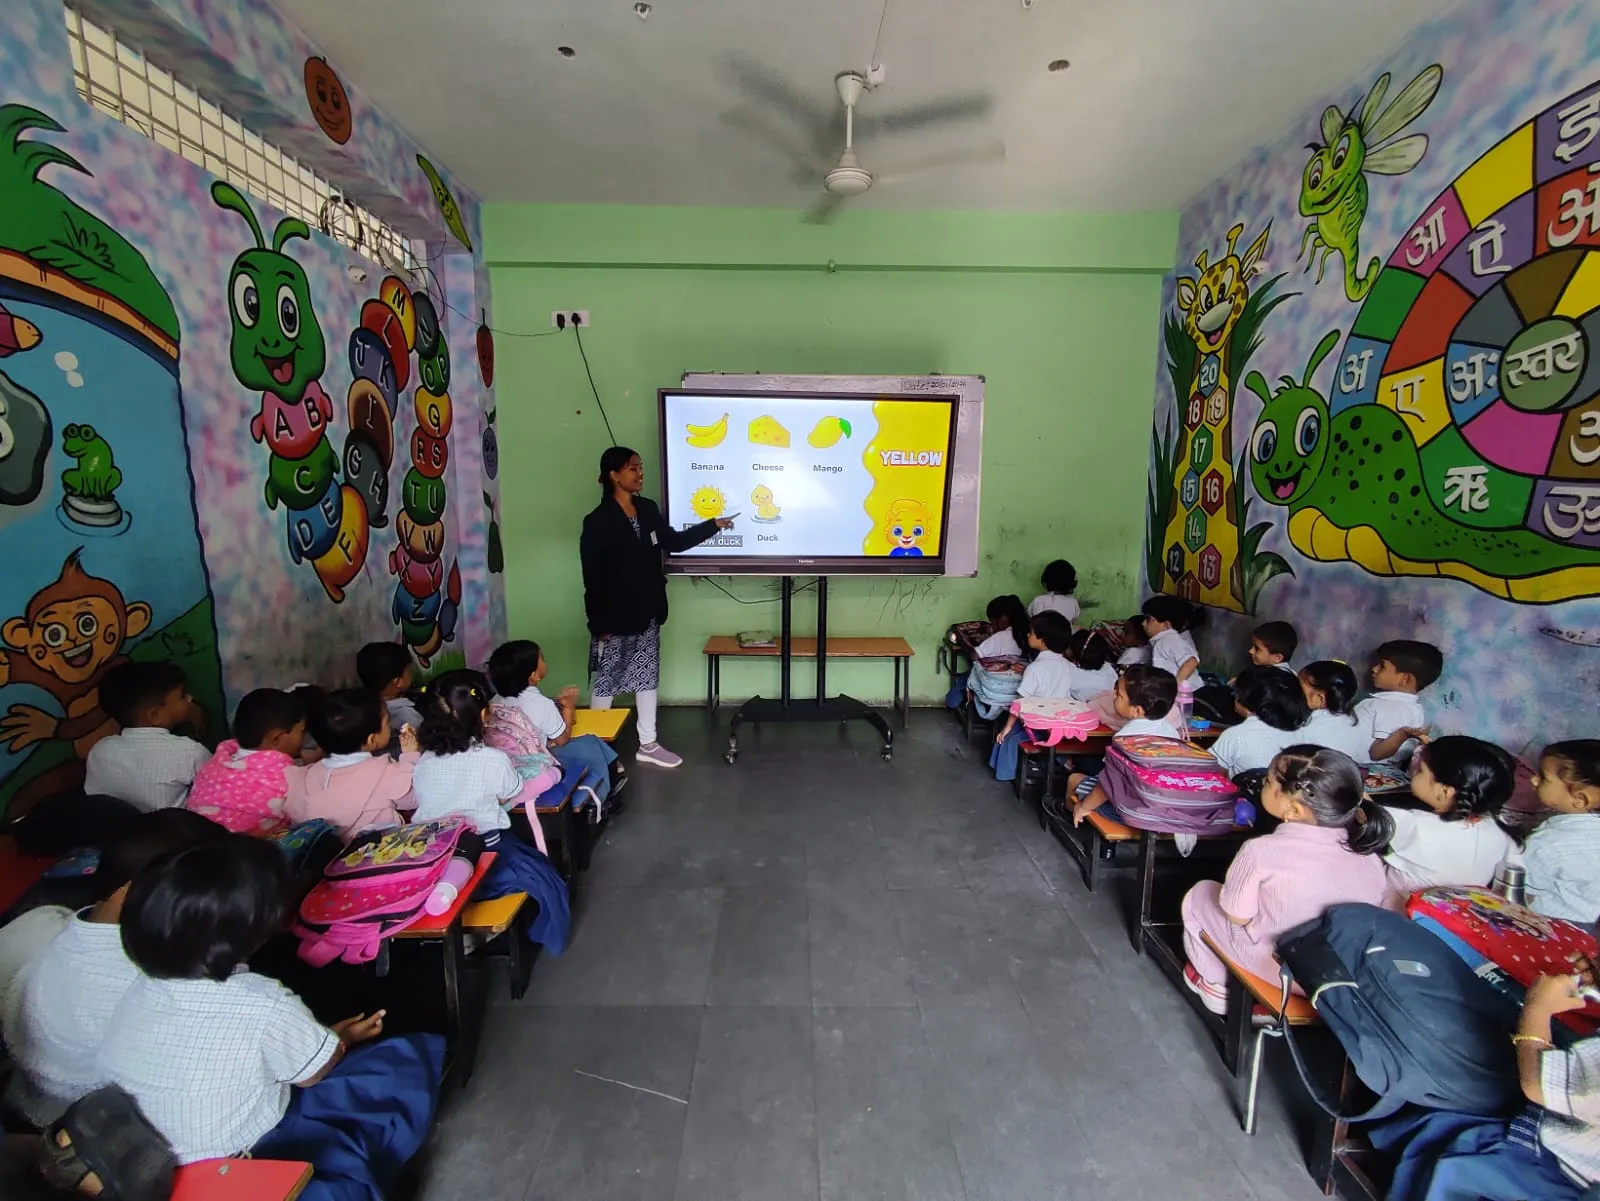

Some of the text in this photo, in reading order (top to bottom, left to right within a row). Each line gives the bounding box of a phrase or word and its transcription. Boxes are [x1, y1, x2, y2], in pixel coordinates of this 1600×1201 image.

[1405, 206, 1448, 266] आ
[391, 287, 406, 317] M
[382, 313, 393, 349] L
[417, 317, 433, 348] N
[355, 336, 390, 392] J K
[424, 354, 447, 391] O P
[1200, 362, 1218, 388] 20
[1339, 349, 1374, 394] अ
[1505, 331, 1582, 387] स्वर
[1188, 397, 1223, 425] 18 19
[1391, 375, 1428, 423] ए
[273, 397, 322, 442] A B
[428, 403, 441, 438] Q
[346, 444, 362, 479] G
[415, 435, 442, 469] R S
[691, 462, 725, 471] Banana
[752, 463, 784, 472] Cheese
[879, 450, 944, 467] YELLOW
[1194, 437, 1207, 464] 17
[294, 465, 315, 494] C
[813, 464, 843, 474] Mango
[369, 470, 384, 505] H
[409, 479, 438, 514] T U
[1182, 478, 1219, 504] 15 16
[295, 497, 340, 551] D E
[402, 520, 436, 555] V W
[717, 536, 741, 546] duck
[757, 533, 779, 542] Duck
[1187, 515, 1201, 544] 14
[338, 531, 354, 565] F
[401, 555, 439, 593] X Y
[1170, 550, 1215, 582] 12 13
[410, 602, 426, 621] Z
